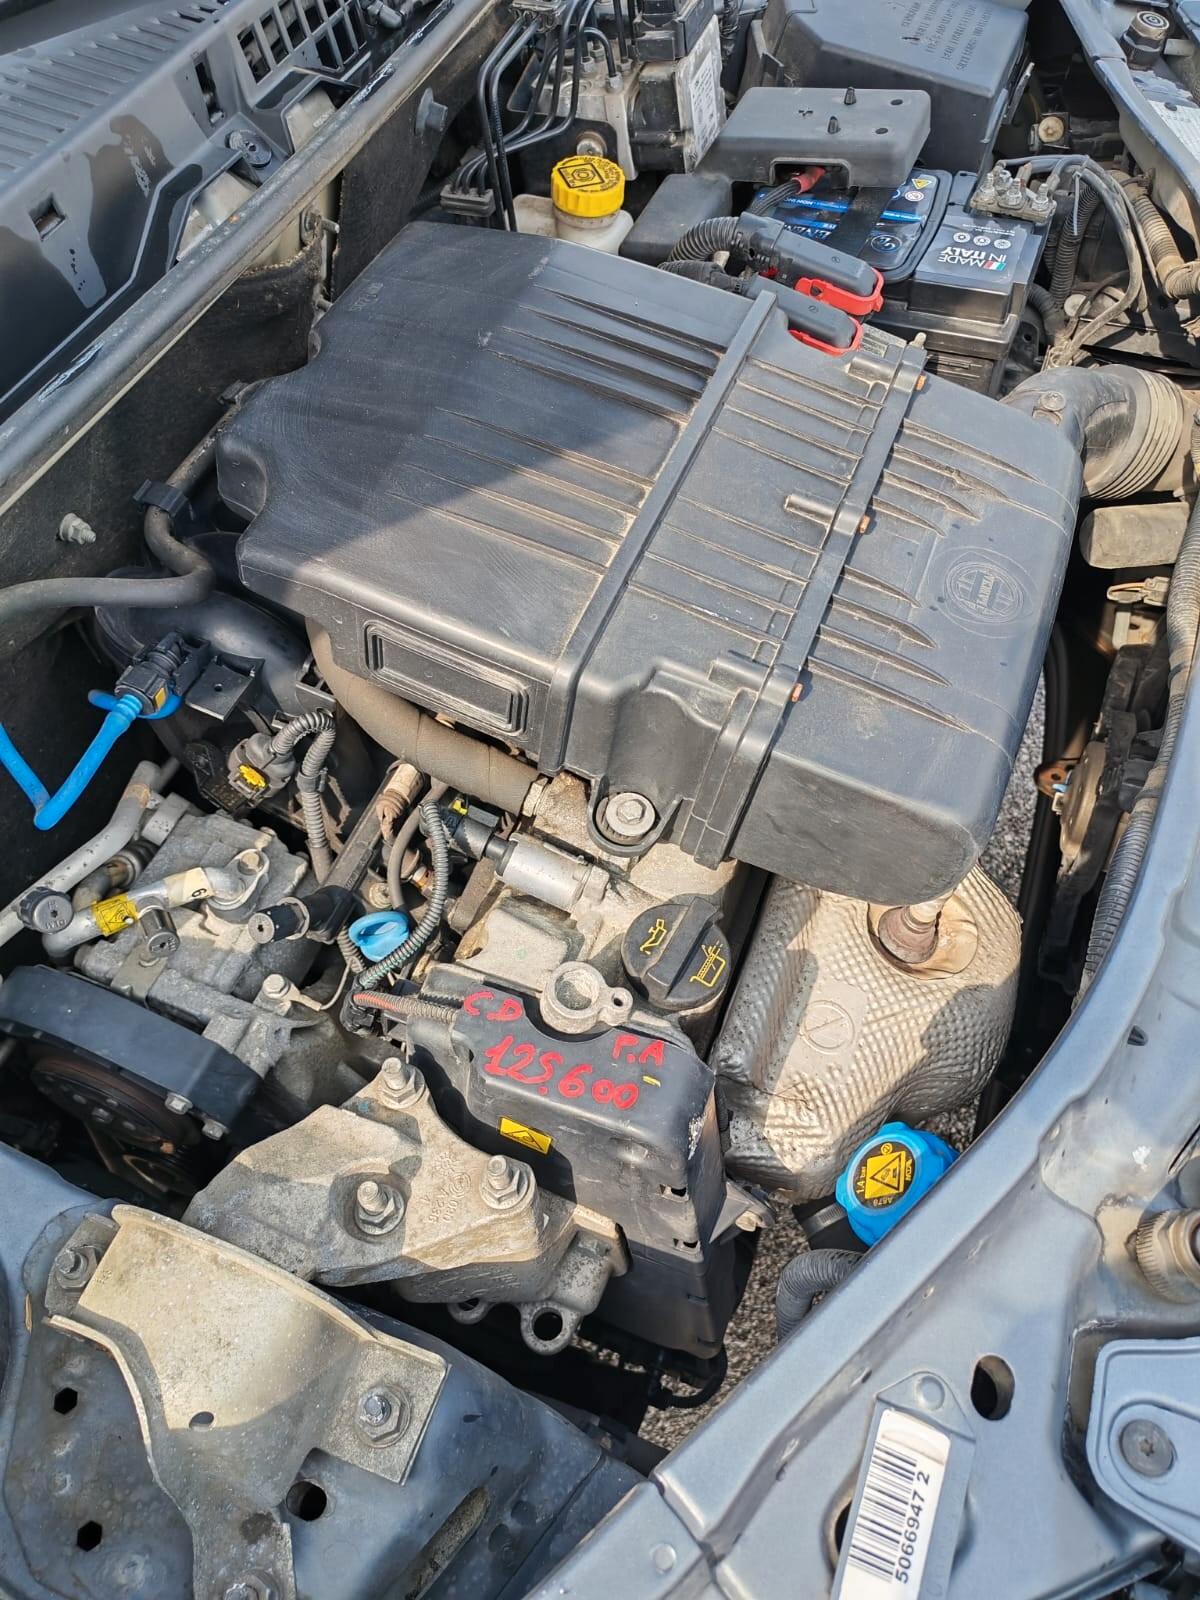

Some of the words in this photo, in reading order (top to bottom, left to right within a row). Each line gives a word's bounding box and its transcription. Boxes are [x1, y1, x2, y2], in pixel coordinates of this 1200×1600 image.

[940, 246, 986, 260] ITALY
[988, 253, 1007, 263] IN
[937, 254, 986, 268] MADE
[483, 1034, 641, 1111] 125.600
[895, 1489, 925, 1584] 5066947
[916, 1471, 930, 1486] 2
